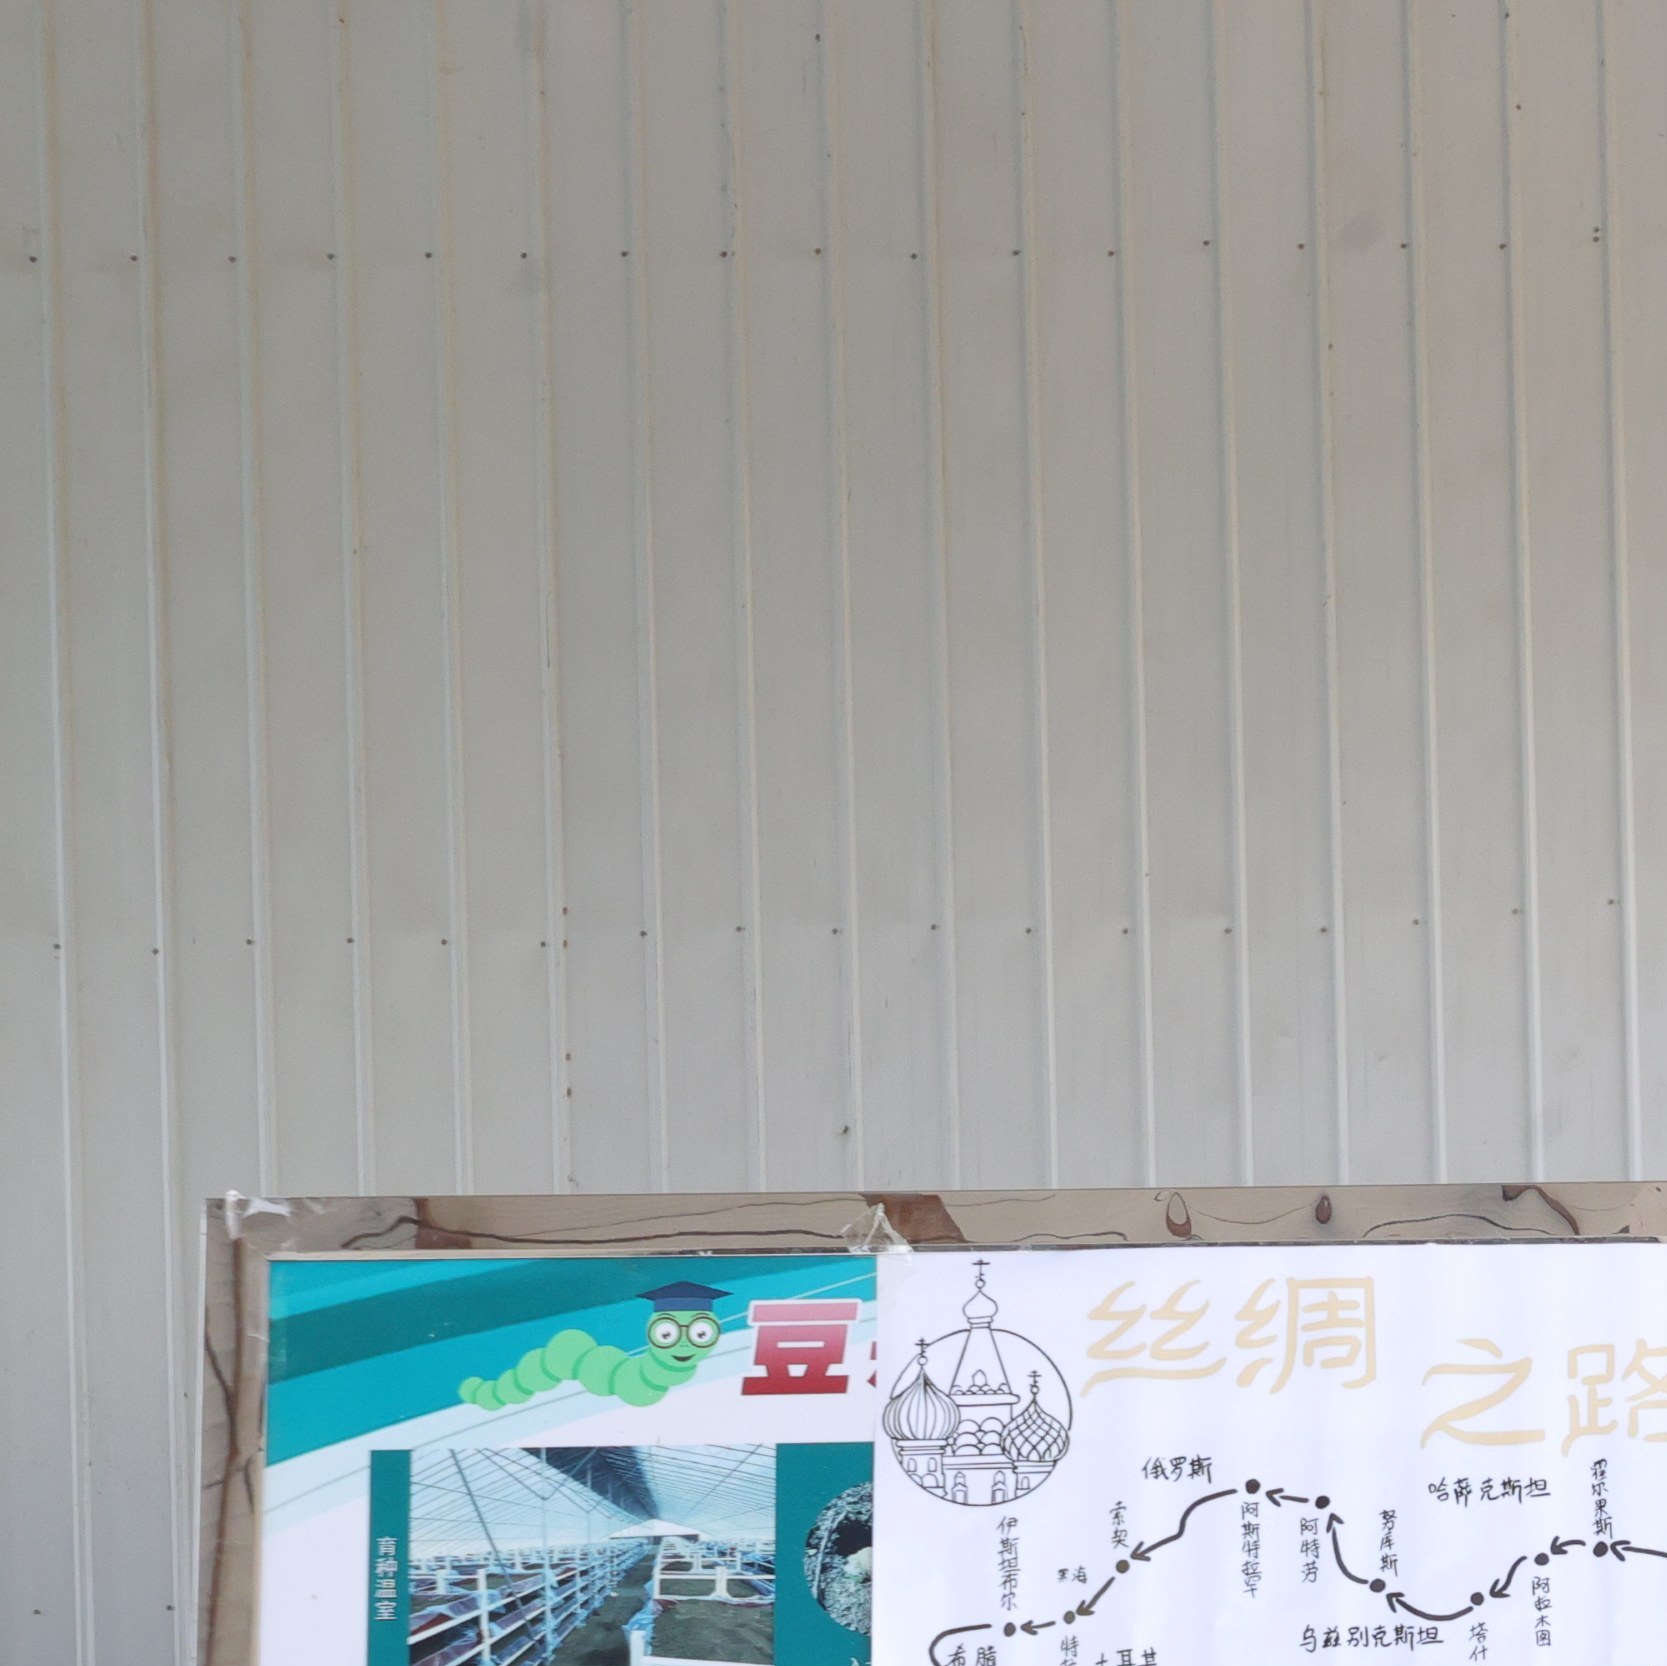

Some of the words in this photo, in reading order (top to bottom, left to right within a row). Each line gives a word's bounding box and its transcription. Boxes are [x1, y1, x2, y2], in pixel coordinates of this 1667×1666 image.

[741, 1299, 876, 1395] 豆
[1141, 1454, 1213, 1485] 俄罗斯
[1427, 1476, 1552, 1508] 哈萨克斯坦
[1590, 1457, 1614, 1540] 霍尔果斯
[1109, 1500, 1129, 1549] 索契
[1240, 1501, 1262, 1598] 阿斯特拉罕
[1299, 1517, 1321, 1584] 阿特劳
[1377, 1509, 1399, 1575] 努库斯
[374, 1536, 398, 1620] 育种温室
[996, 1516, 1021, 1612] 伊斯坦布尔
[1299, 1624, 1444, 1652] 乌兹别克斯坦
[1531, 1575, 1553, 1647] 阿拉木图
